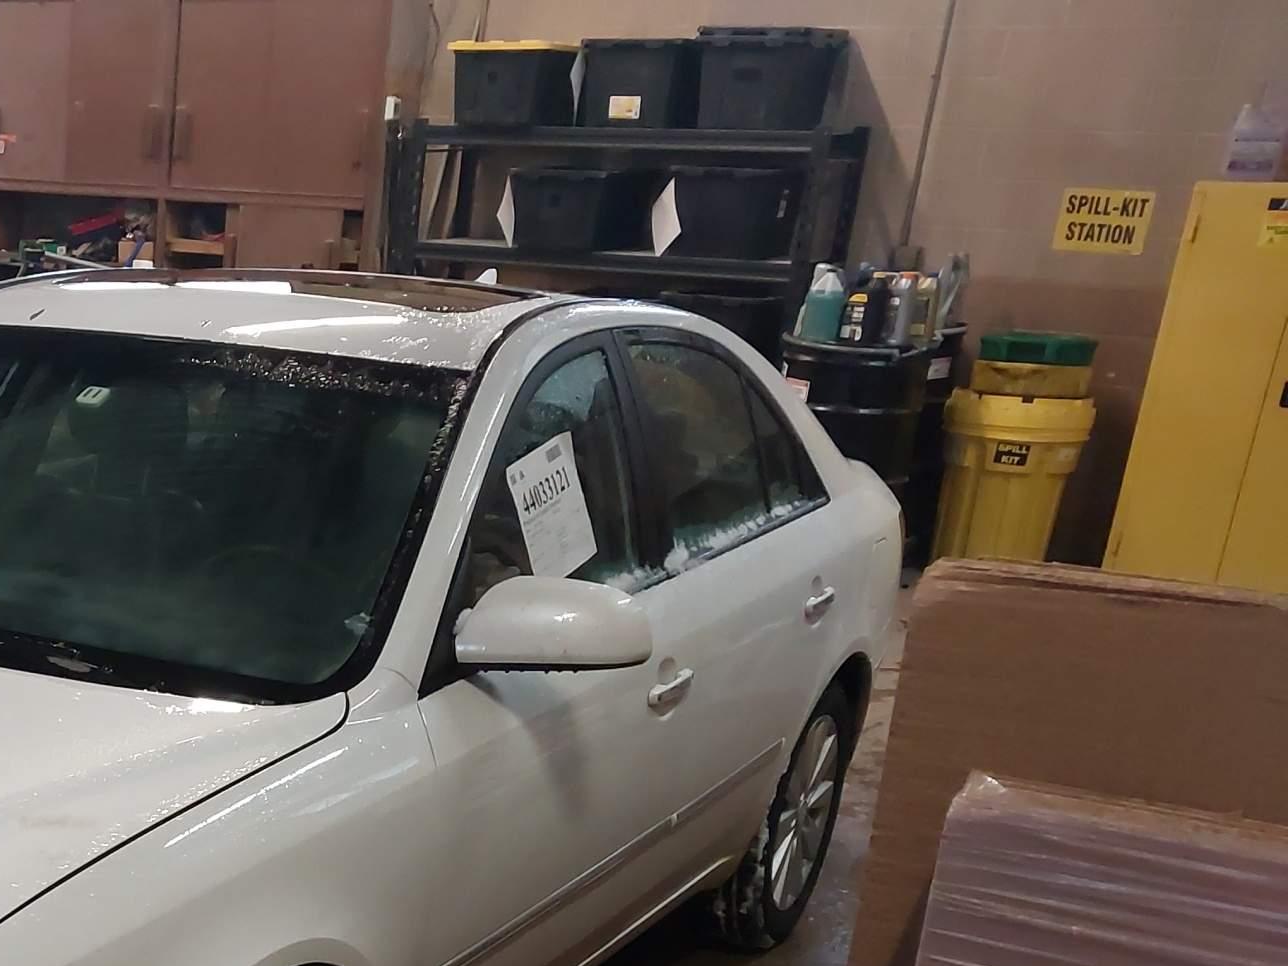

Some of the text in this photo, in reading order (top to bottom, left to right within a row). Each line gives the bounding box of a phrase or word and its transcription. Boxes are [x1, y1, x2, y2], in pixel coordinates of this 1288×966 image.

[1066, 194, 1150, 218] SPILL-KIT
[1065, 221, 1135, 245] STATION
[998, 443, 1028, 454] SPILL
[1000, 455, 1020, 464] KIT
[522, 467, 570, 515] 44033121
